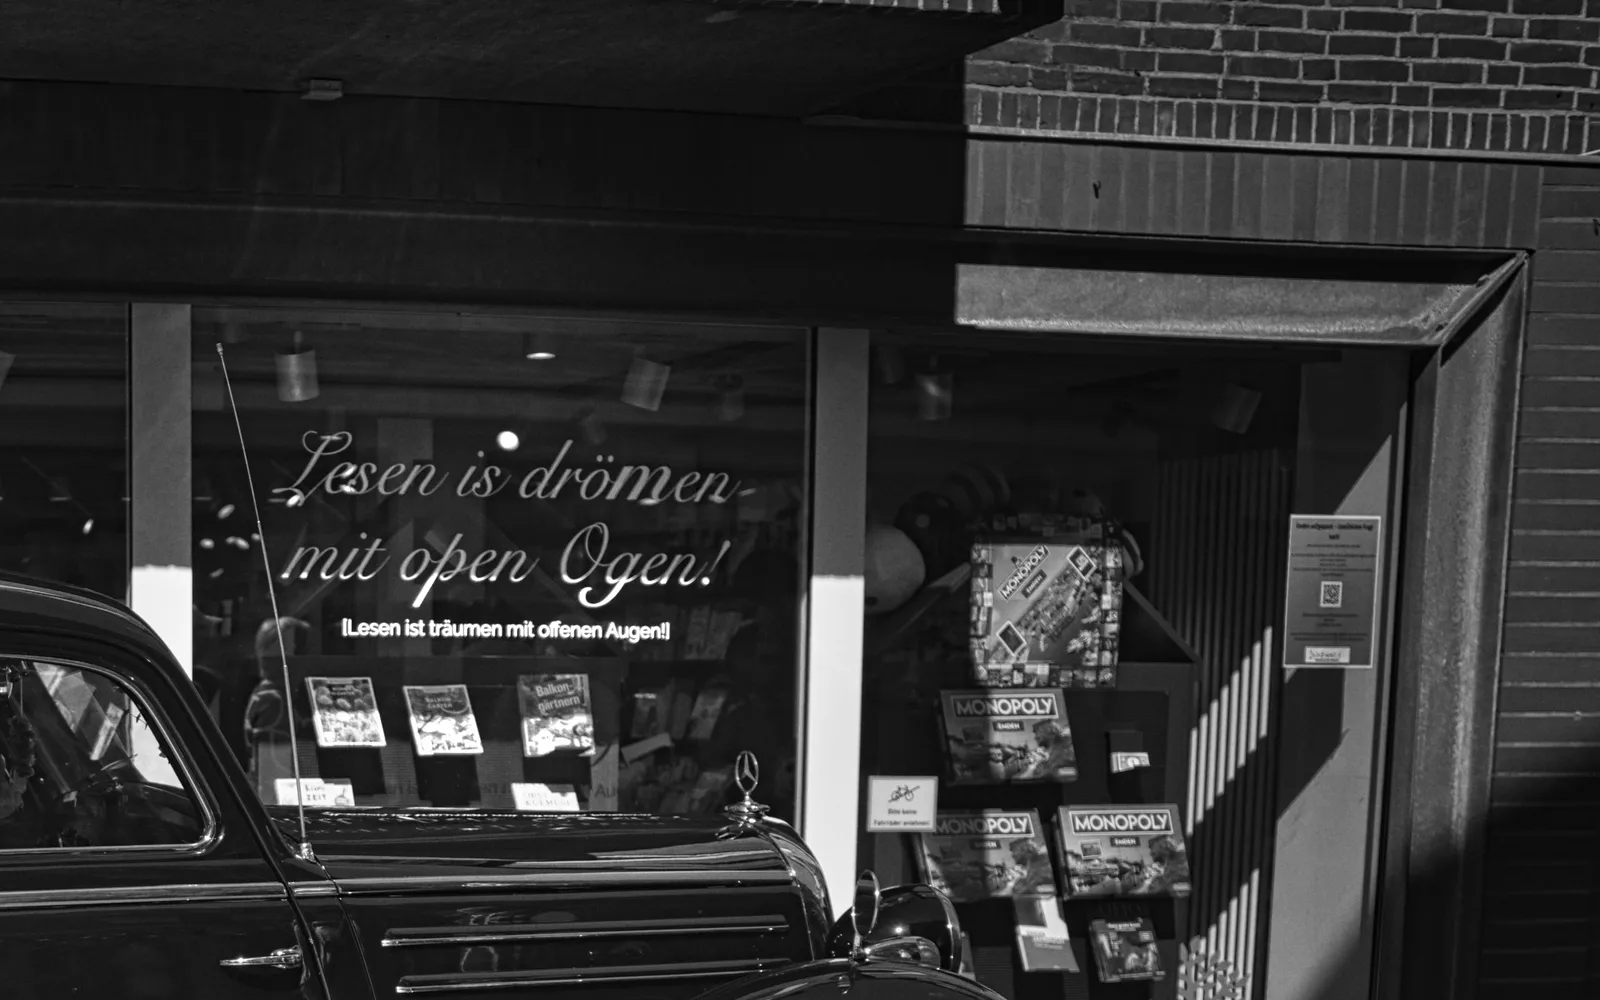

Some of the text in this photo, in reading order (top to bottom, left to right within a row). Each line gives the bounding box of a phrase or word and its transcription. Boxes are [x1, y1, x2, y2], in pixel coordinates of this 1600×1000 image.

[271, 430, 745, 506] Lesen is drömen
[280, 521, 731, 608] mit open Ogen!
[1001, 546, 1046, 597] MONOPOLY
[404, 618, 425, 637] ist
[428, 619, 502, 638] träumen
[506, 620, 535, 638] mit
[538, 620, 602, 639] offenen
[535, 682, 573, 697] Balkon-
[538, 695, 581, 715] gärtnern
[956, 697, 1053, 716] MONOPOLY
[997, 722, 1020, 730] EMDEN
[934, 817, 1029, 834] MONOPOLY
[1074, 813, 1168, 832] MONOPOLY
